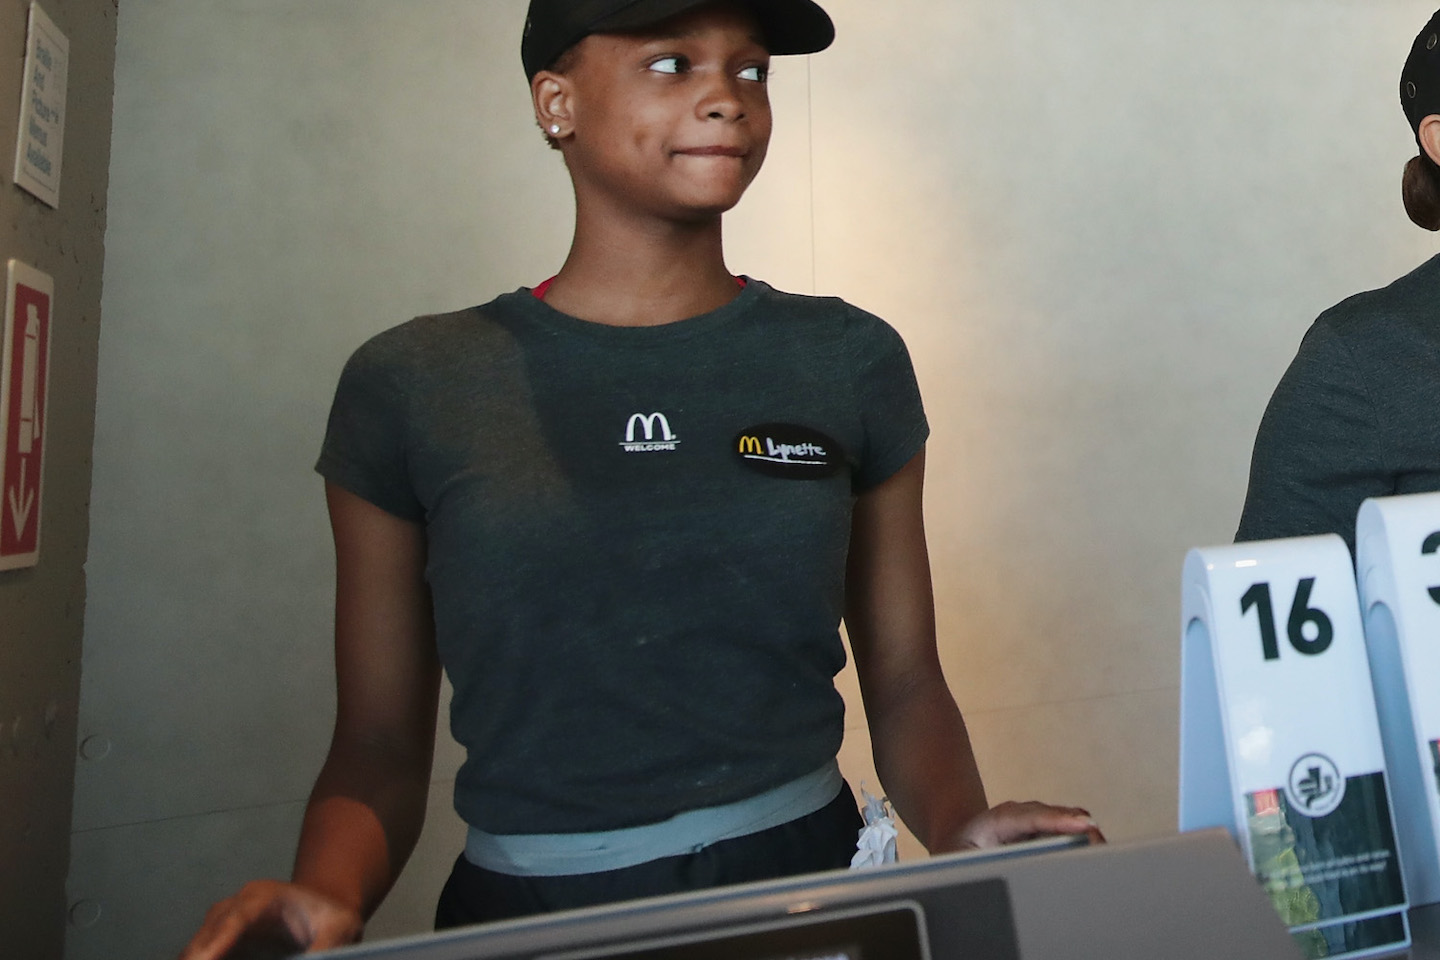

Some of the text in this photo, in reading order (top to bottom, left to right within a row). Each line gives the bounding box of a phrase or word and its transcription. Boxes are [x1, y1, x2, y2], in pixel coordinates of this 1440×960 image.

[623, 443, 676, 452] WELCOME
[766, 437, 827, 461] Lynette
[1239, 576, 1334, 661] 16
